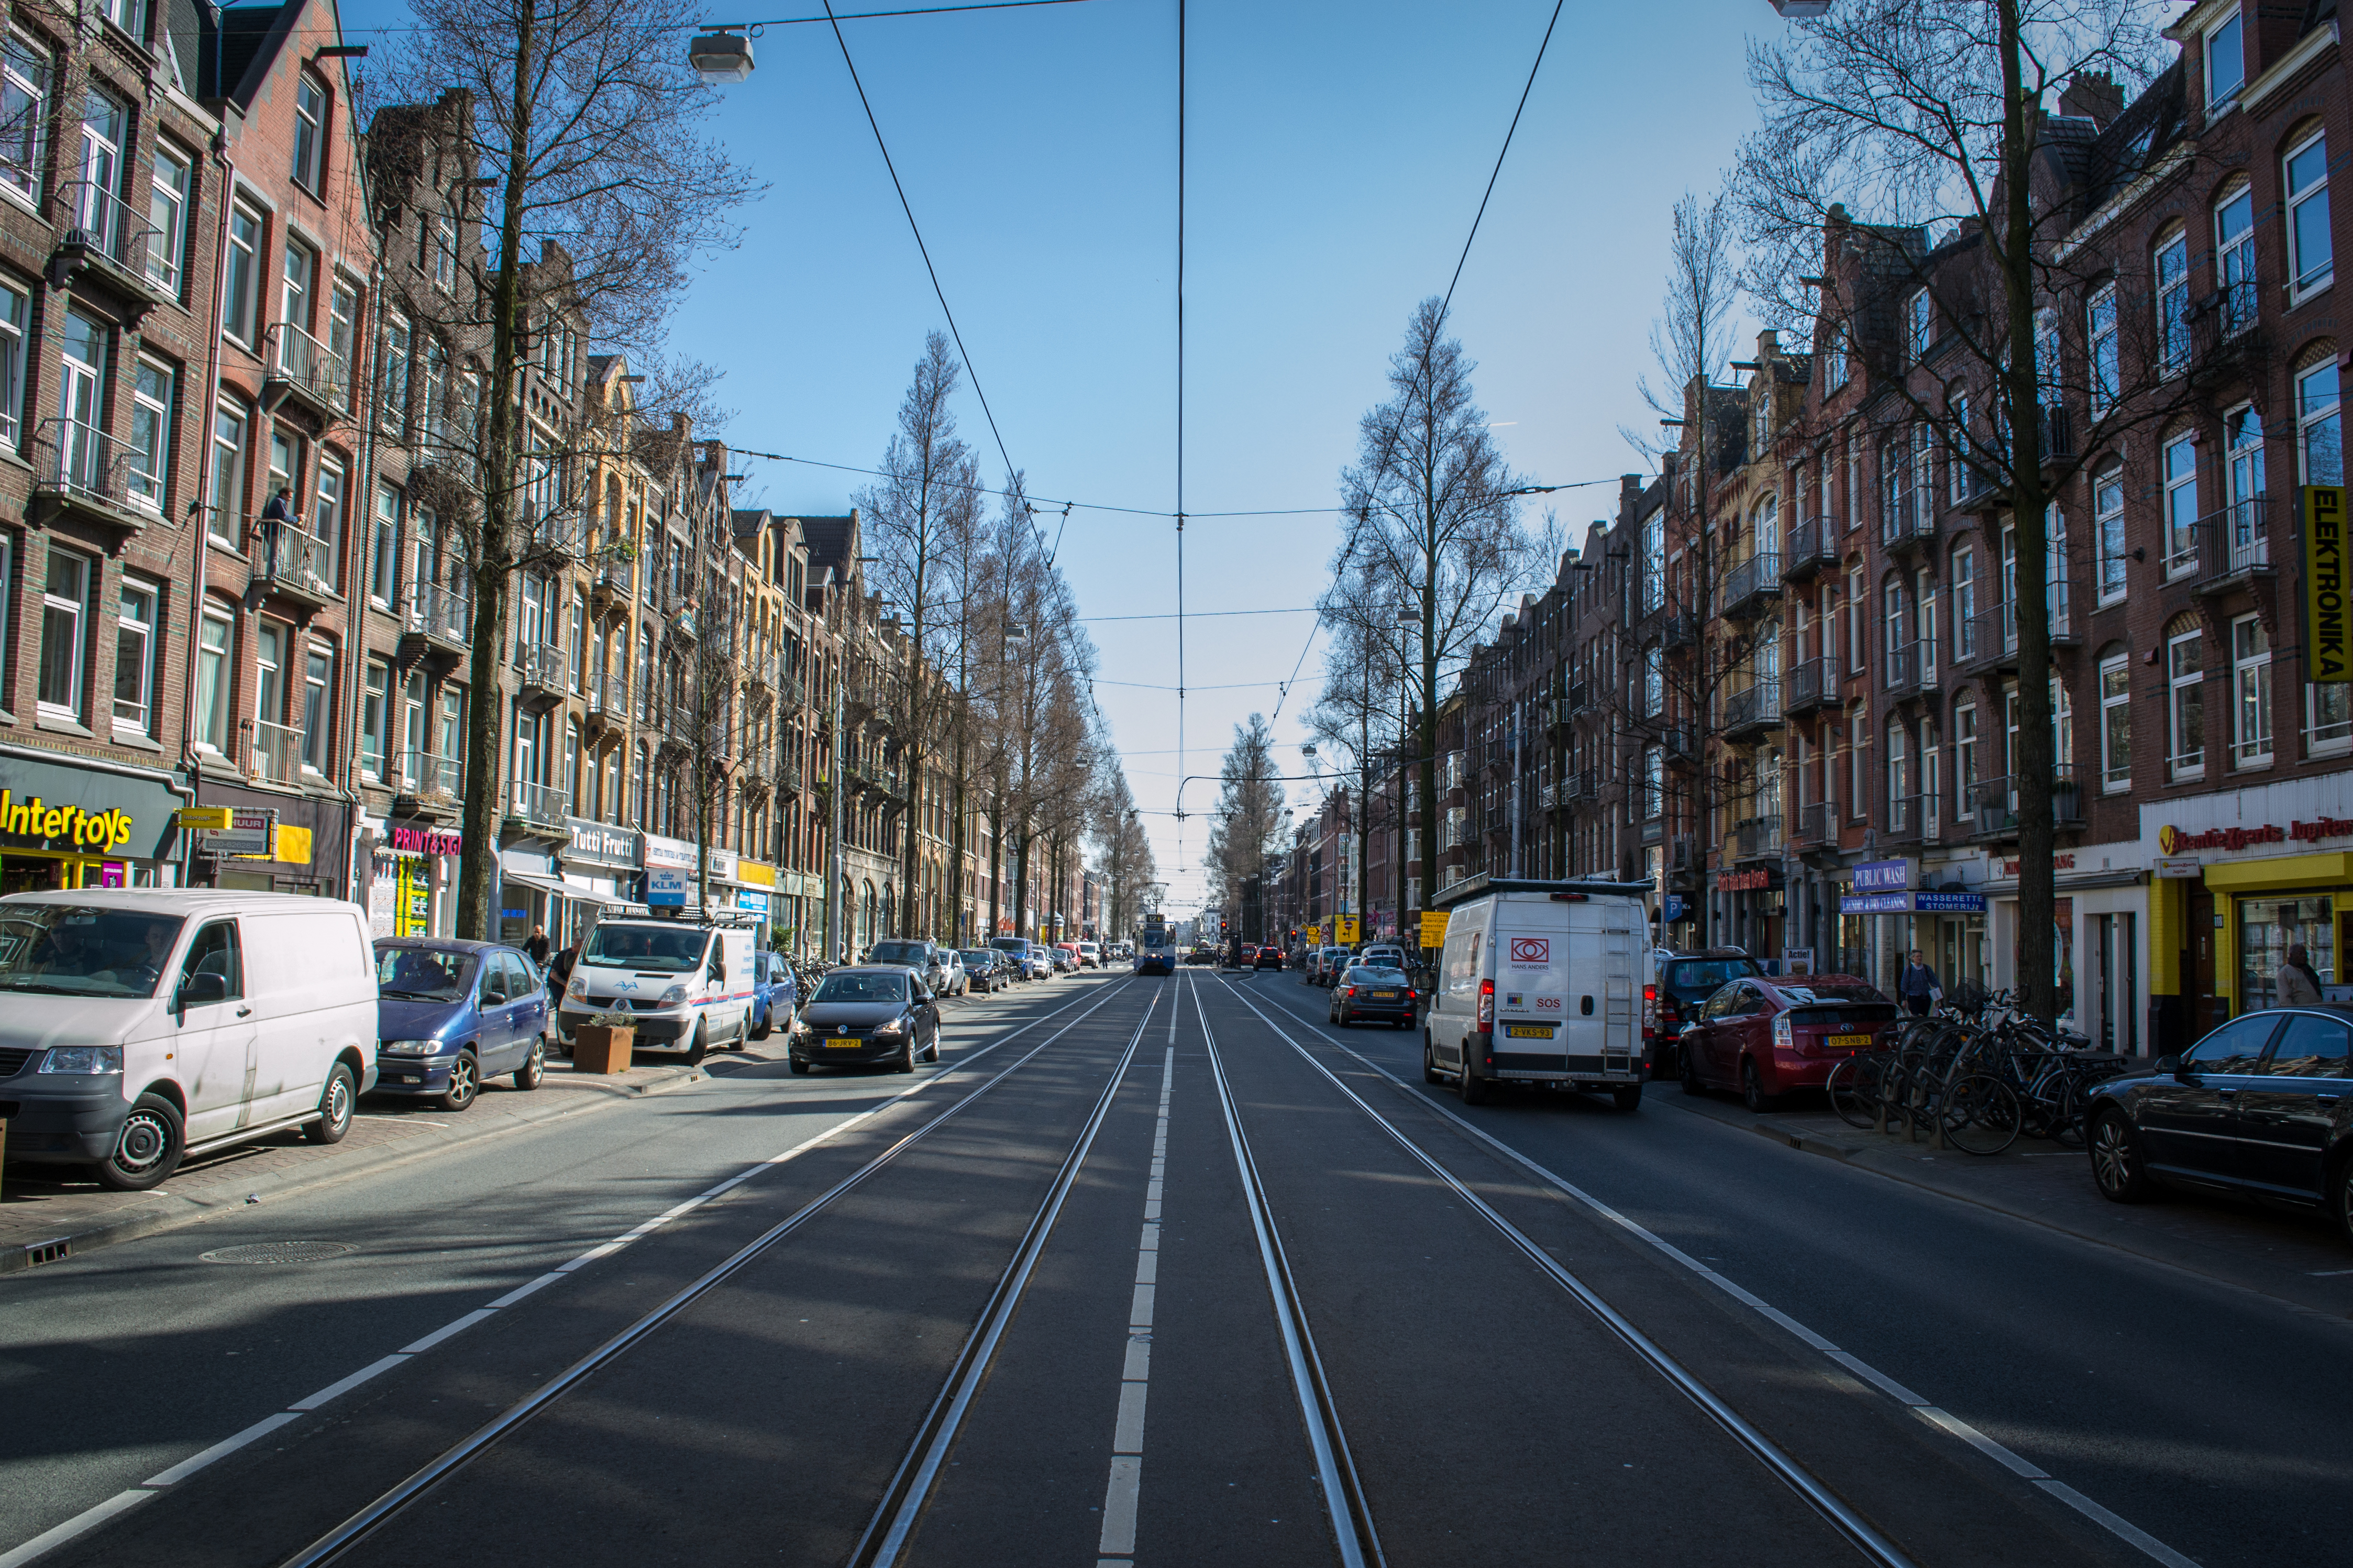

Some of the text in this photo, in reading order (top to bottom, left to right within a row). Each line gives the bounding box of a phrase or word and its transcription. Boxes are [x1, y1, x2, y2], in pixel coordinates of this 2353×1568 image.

[2313, 489, 2344, 677] ELEKTRONIKA
[0, 789, 132, 853] Intertoys
[2160, 816, 2353, 853] VakantieXperts Jupiter
[209, 841, 260, 849] 020-6262827
[571, 825, 600, 853] Tutti
[603, 832, 633, 858] Frutti
[1855, 866, 1906, 887] PUBLIC WASH
[651, 881, 682, 889] KLM
[1670, 902, 1677, 914] P
[1842, 896, 1907, 911] LAUNDRY & DRY CLEANING
[2214, 915, 2223, 927] 118
[1788, 950, 1809, 959] Actie!
[1537, 998, 1560, 1008] SOS
[1513, 1028, 1550, 1036] 2-VKS-93
[1831, 1036, 1869, 1045] 07-SNB-2
